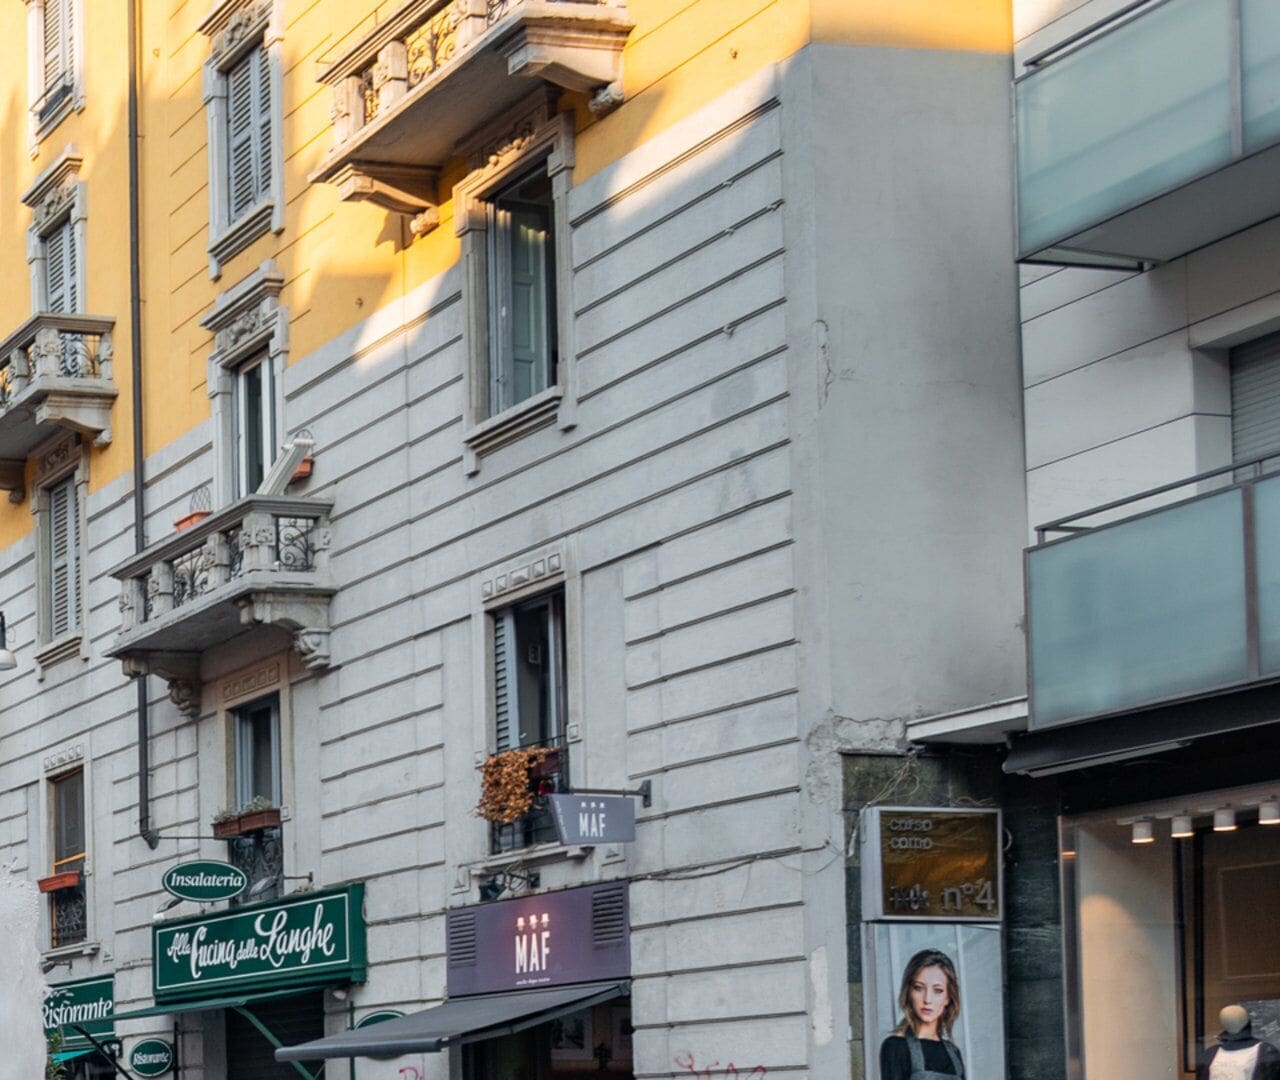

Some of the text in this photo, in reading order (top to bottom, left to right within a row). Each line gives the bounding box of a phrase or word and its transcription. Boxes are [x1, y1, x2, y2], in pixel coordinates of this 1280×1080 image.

[579, 812, 606, 837] MAF
[890, 819, 933, 831] corso
[890, 837, 933, 849] como
[170, 872, 243, 887] Insalateria
[942, 880, 996, 911] n°4
[167, 903, 335, 979] Alla Cucina delle Langhe
[515, 931, 550, 974] MAF
[41, 997, 113, 1029] Ristorante
[133, 1052, 169, 1066] Ristorante
